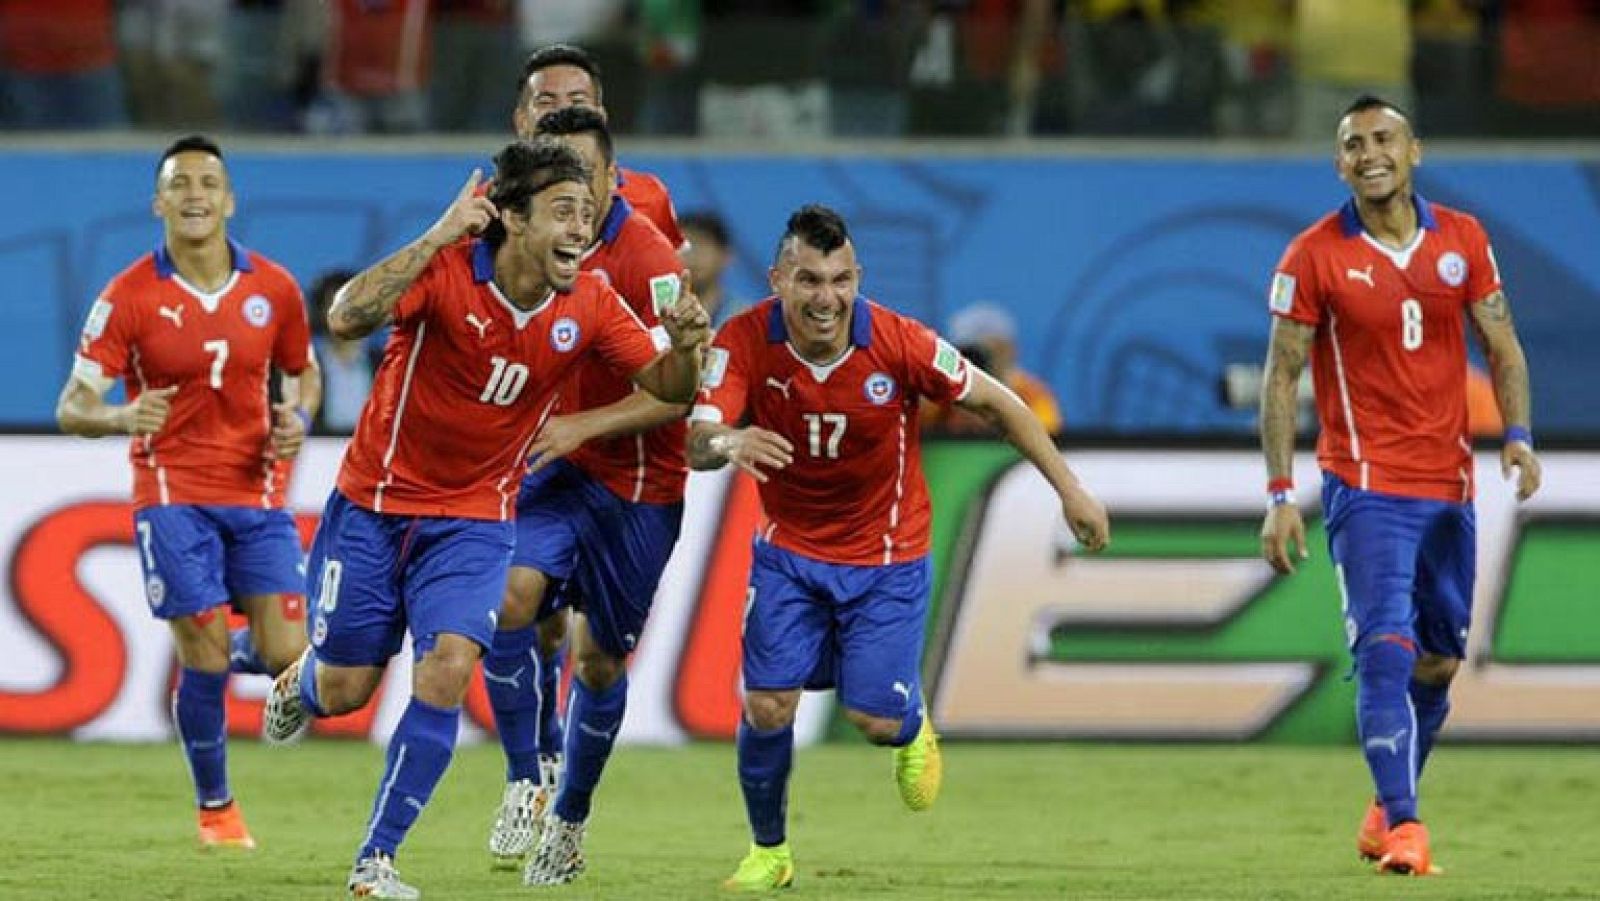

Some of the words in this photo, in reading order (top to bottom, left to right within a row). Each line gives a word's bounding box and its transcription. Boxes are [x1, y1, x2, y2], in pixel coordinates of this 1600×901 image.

[1401, 298, 1423, 351] 8
[203, 340, 229, 389] 7
[480, 356, 529, 406] 10
[802, 413, 848, 459] 17
